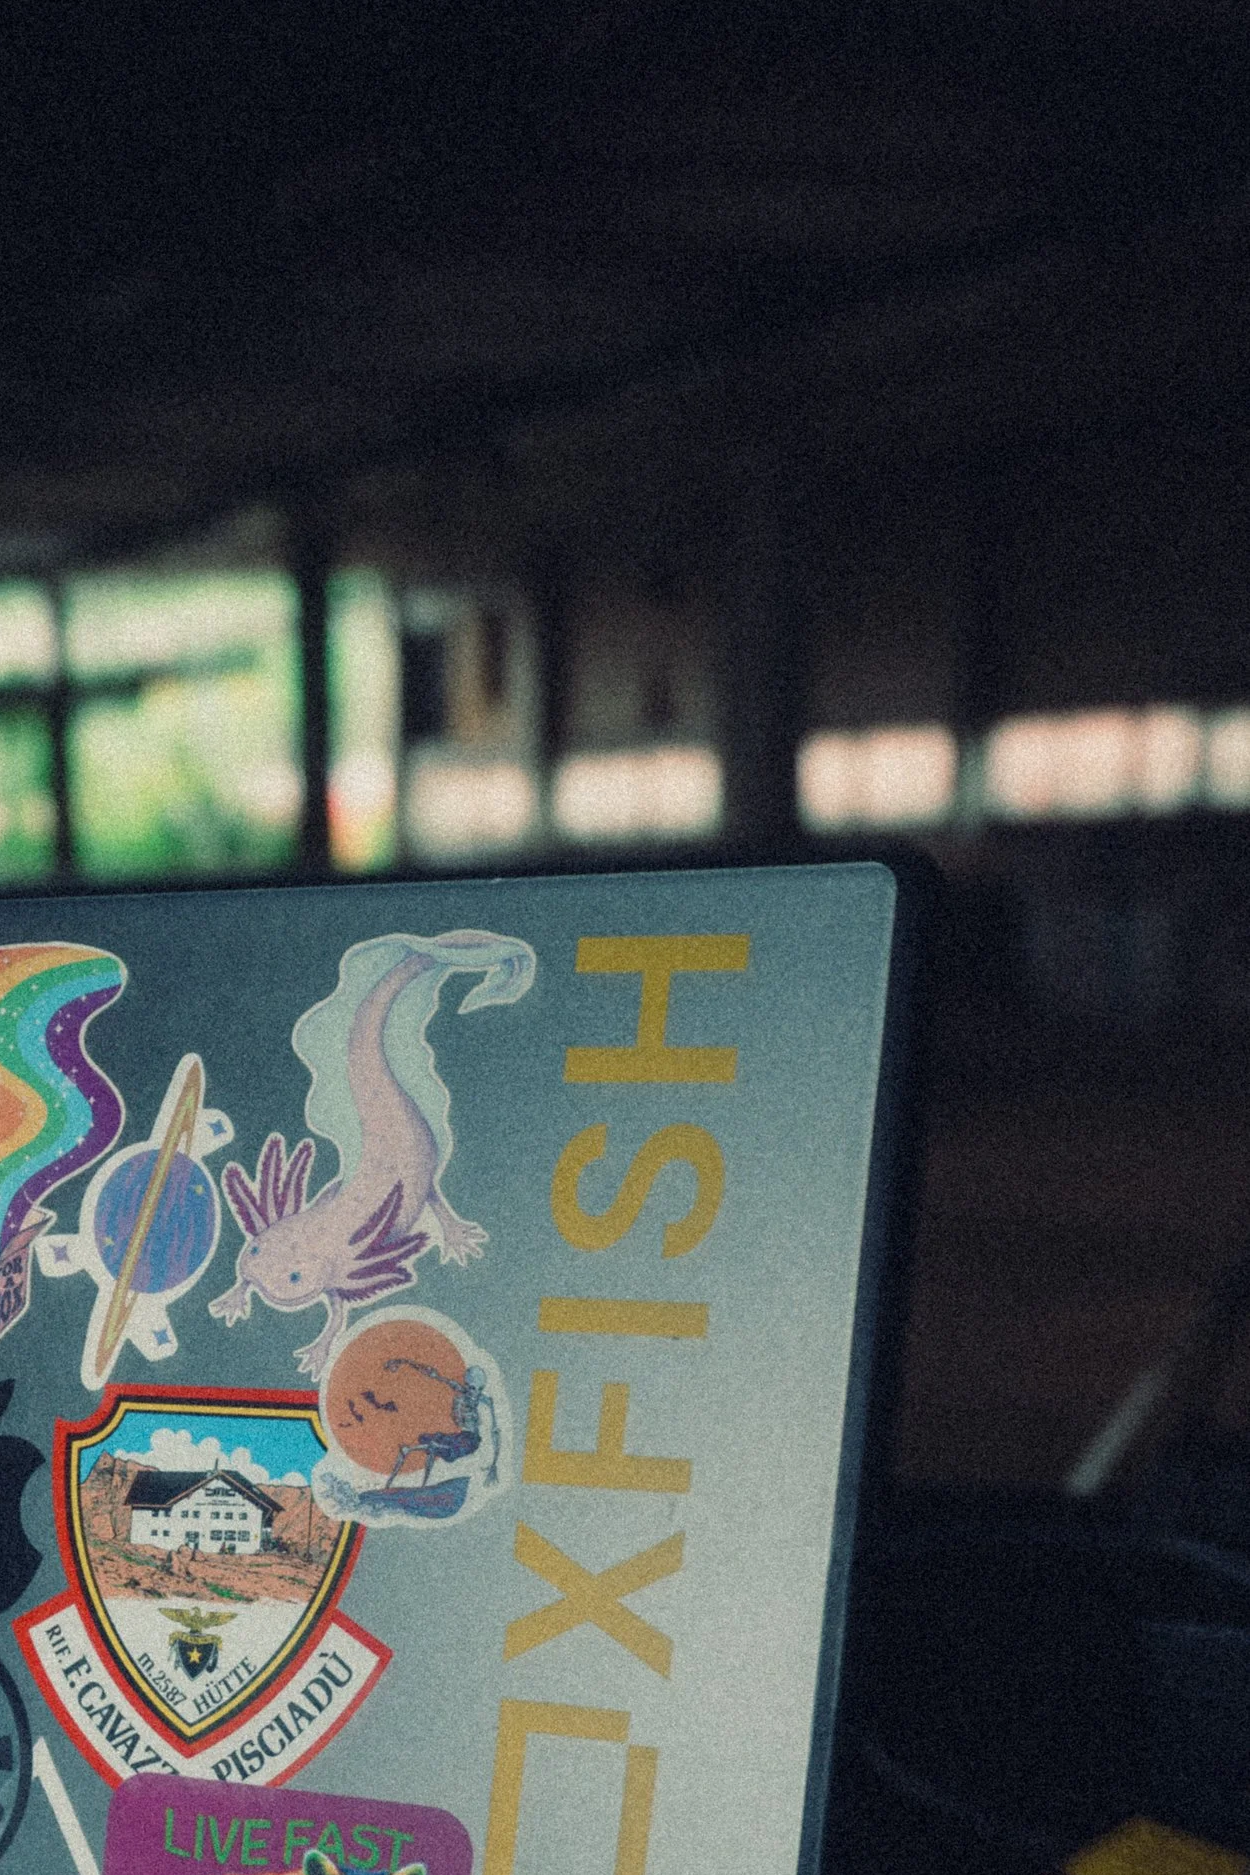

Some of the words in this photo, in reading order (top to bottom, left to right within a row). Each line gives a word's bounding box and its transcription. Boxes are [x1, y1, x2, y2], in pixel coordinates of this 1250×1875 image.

[4, 1276, 15, 1289] A
[46, 1624, 71, 1664] RIF.
[211, 1650, 354, 1781] PISCIADÙ
[192, 1656, 257, 1715] HÜTTE
[164, 1807, 272, 1866] LIVE
[283, 1818, 414, 1872] FAST
